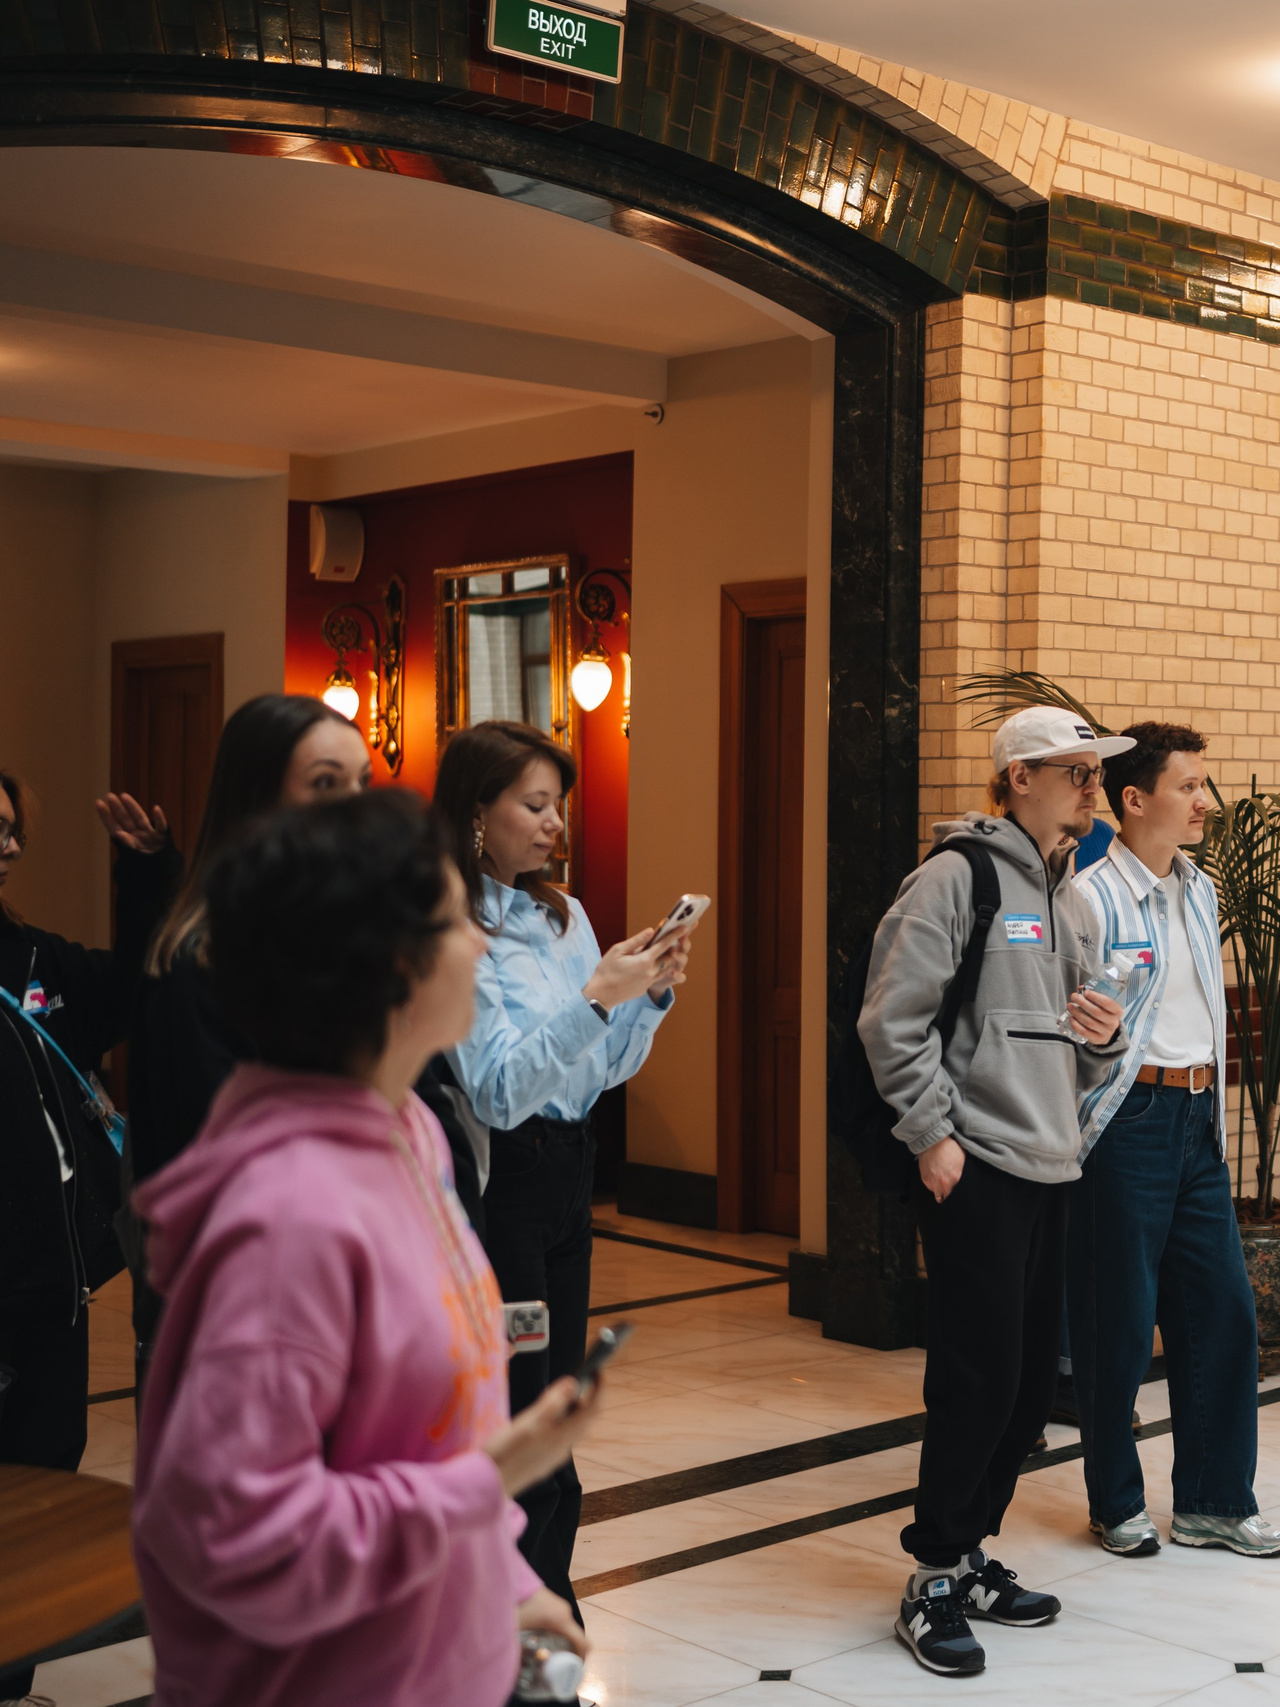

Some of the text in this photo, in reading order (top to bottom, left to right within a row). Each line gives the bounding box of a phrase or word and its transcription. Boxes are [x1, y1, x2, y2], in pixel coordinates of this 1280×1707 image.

[528, 8, 587, 47] ВЫХОД
[540, 37, 576, 59] EXIT
[969, 1583, 1000, 1612] N
[908, 1610, 932, 1644] N
